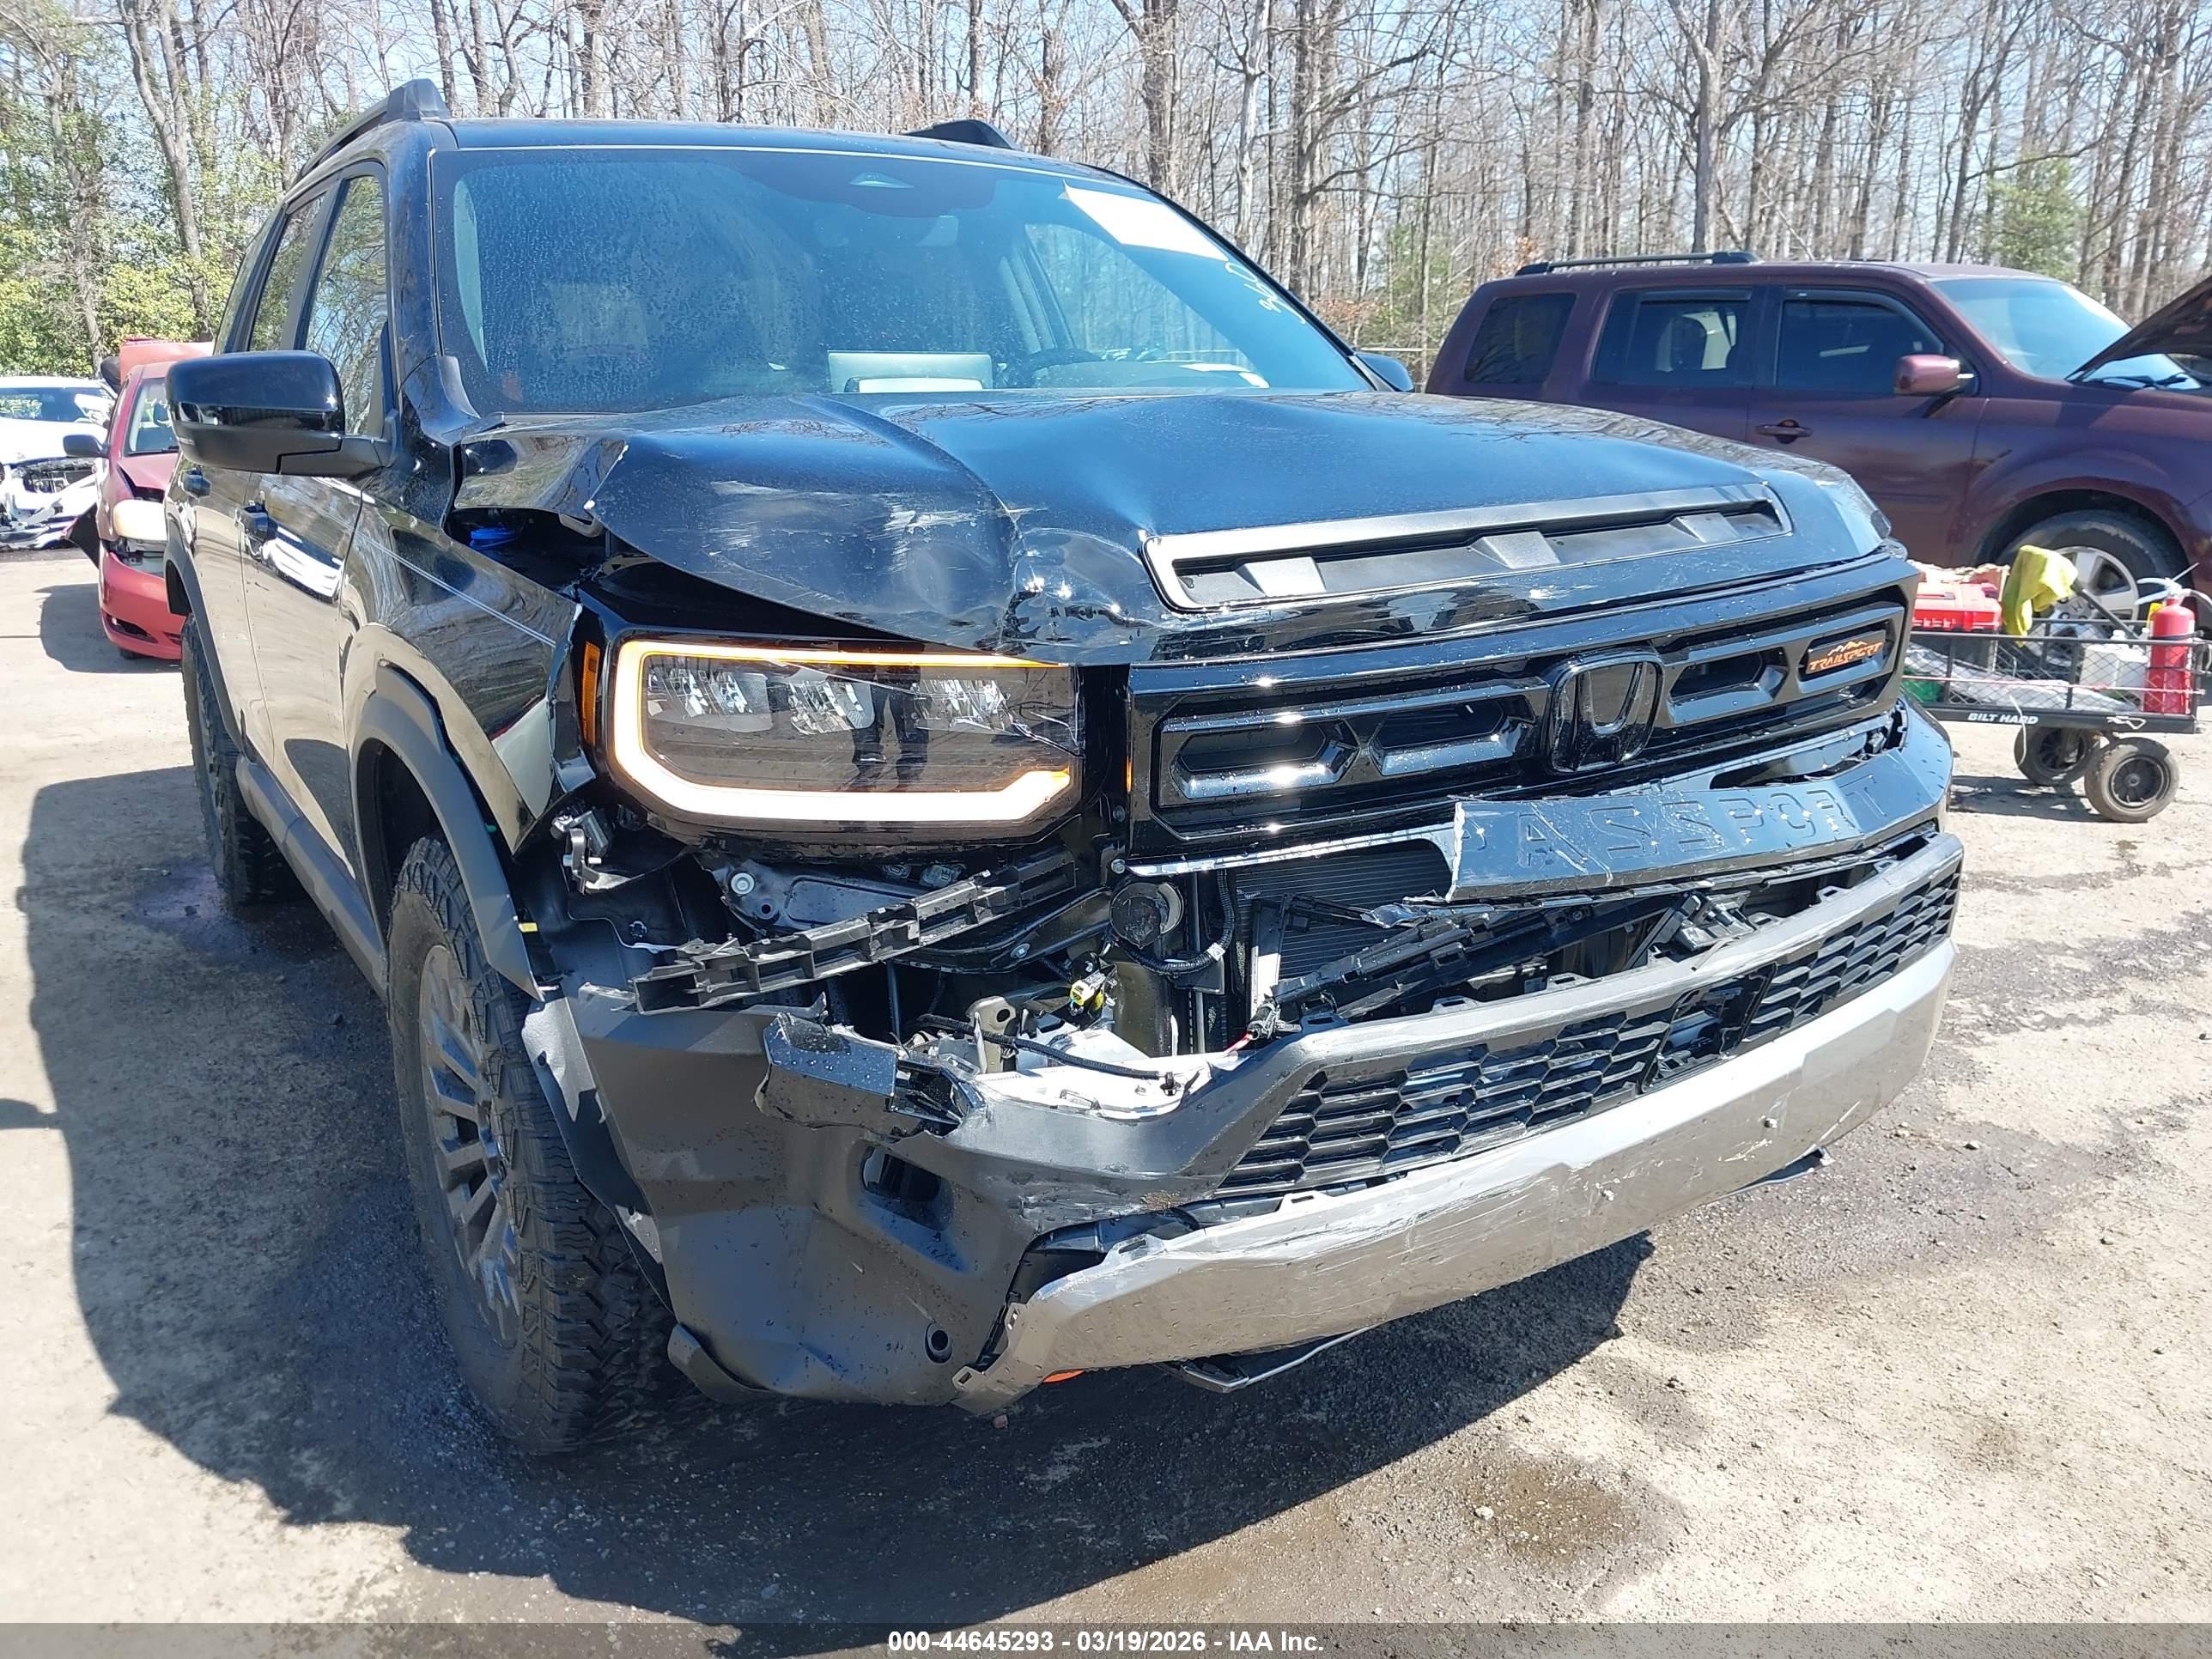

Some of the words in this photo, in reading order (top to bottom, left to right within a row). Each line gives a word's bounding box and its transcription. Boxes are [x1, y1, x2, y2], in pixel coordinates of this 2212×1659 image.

[1808, 641, 1883, 671] TRAILSPORT
[1967, 712, 1998, 722] BILT
[1998, 714, 2039, 725] HARD
